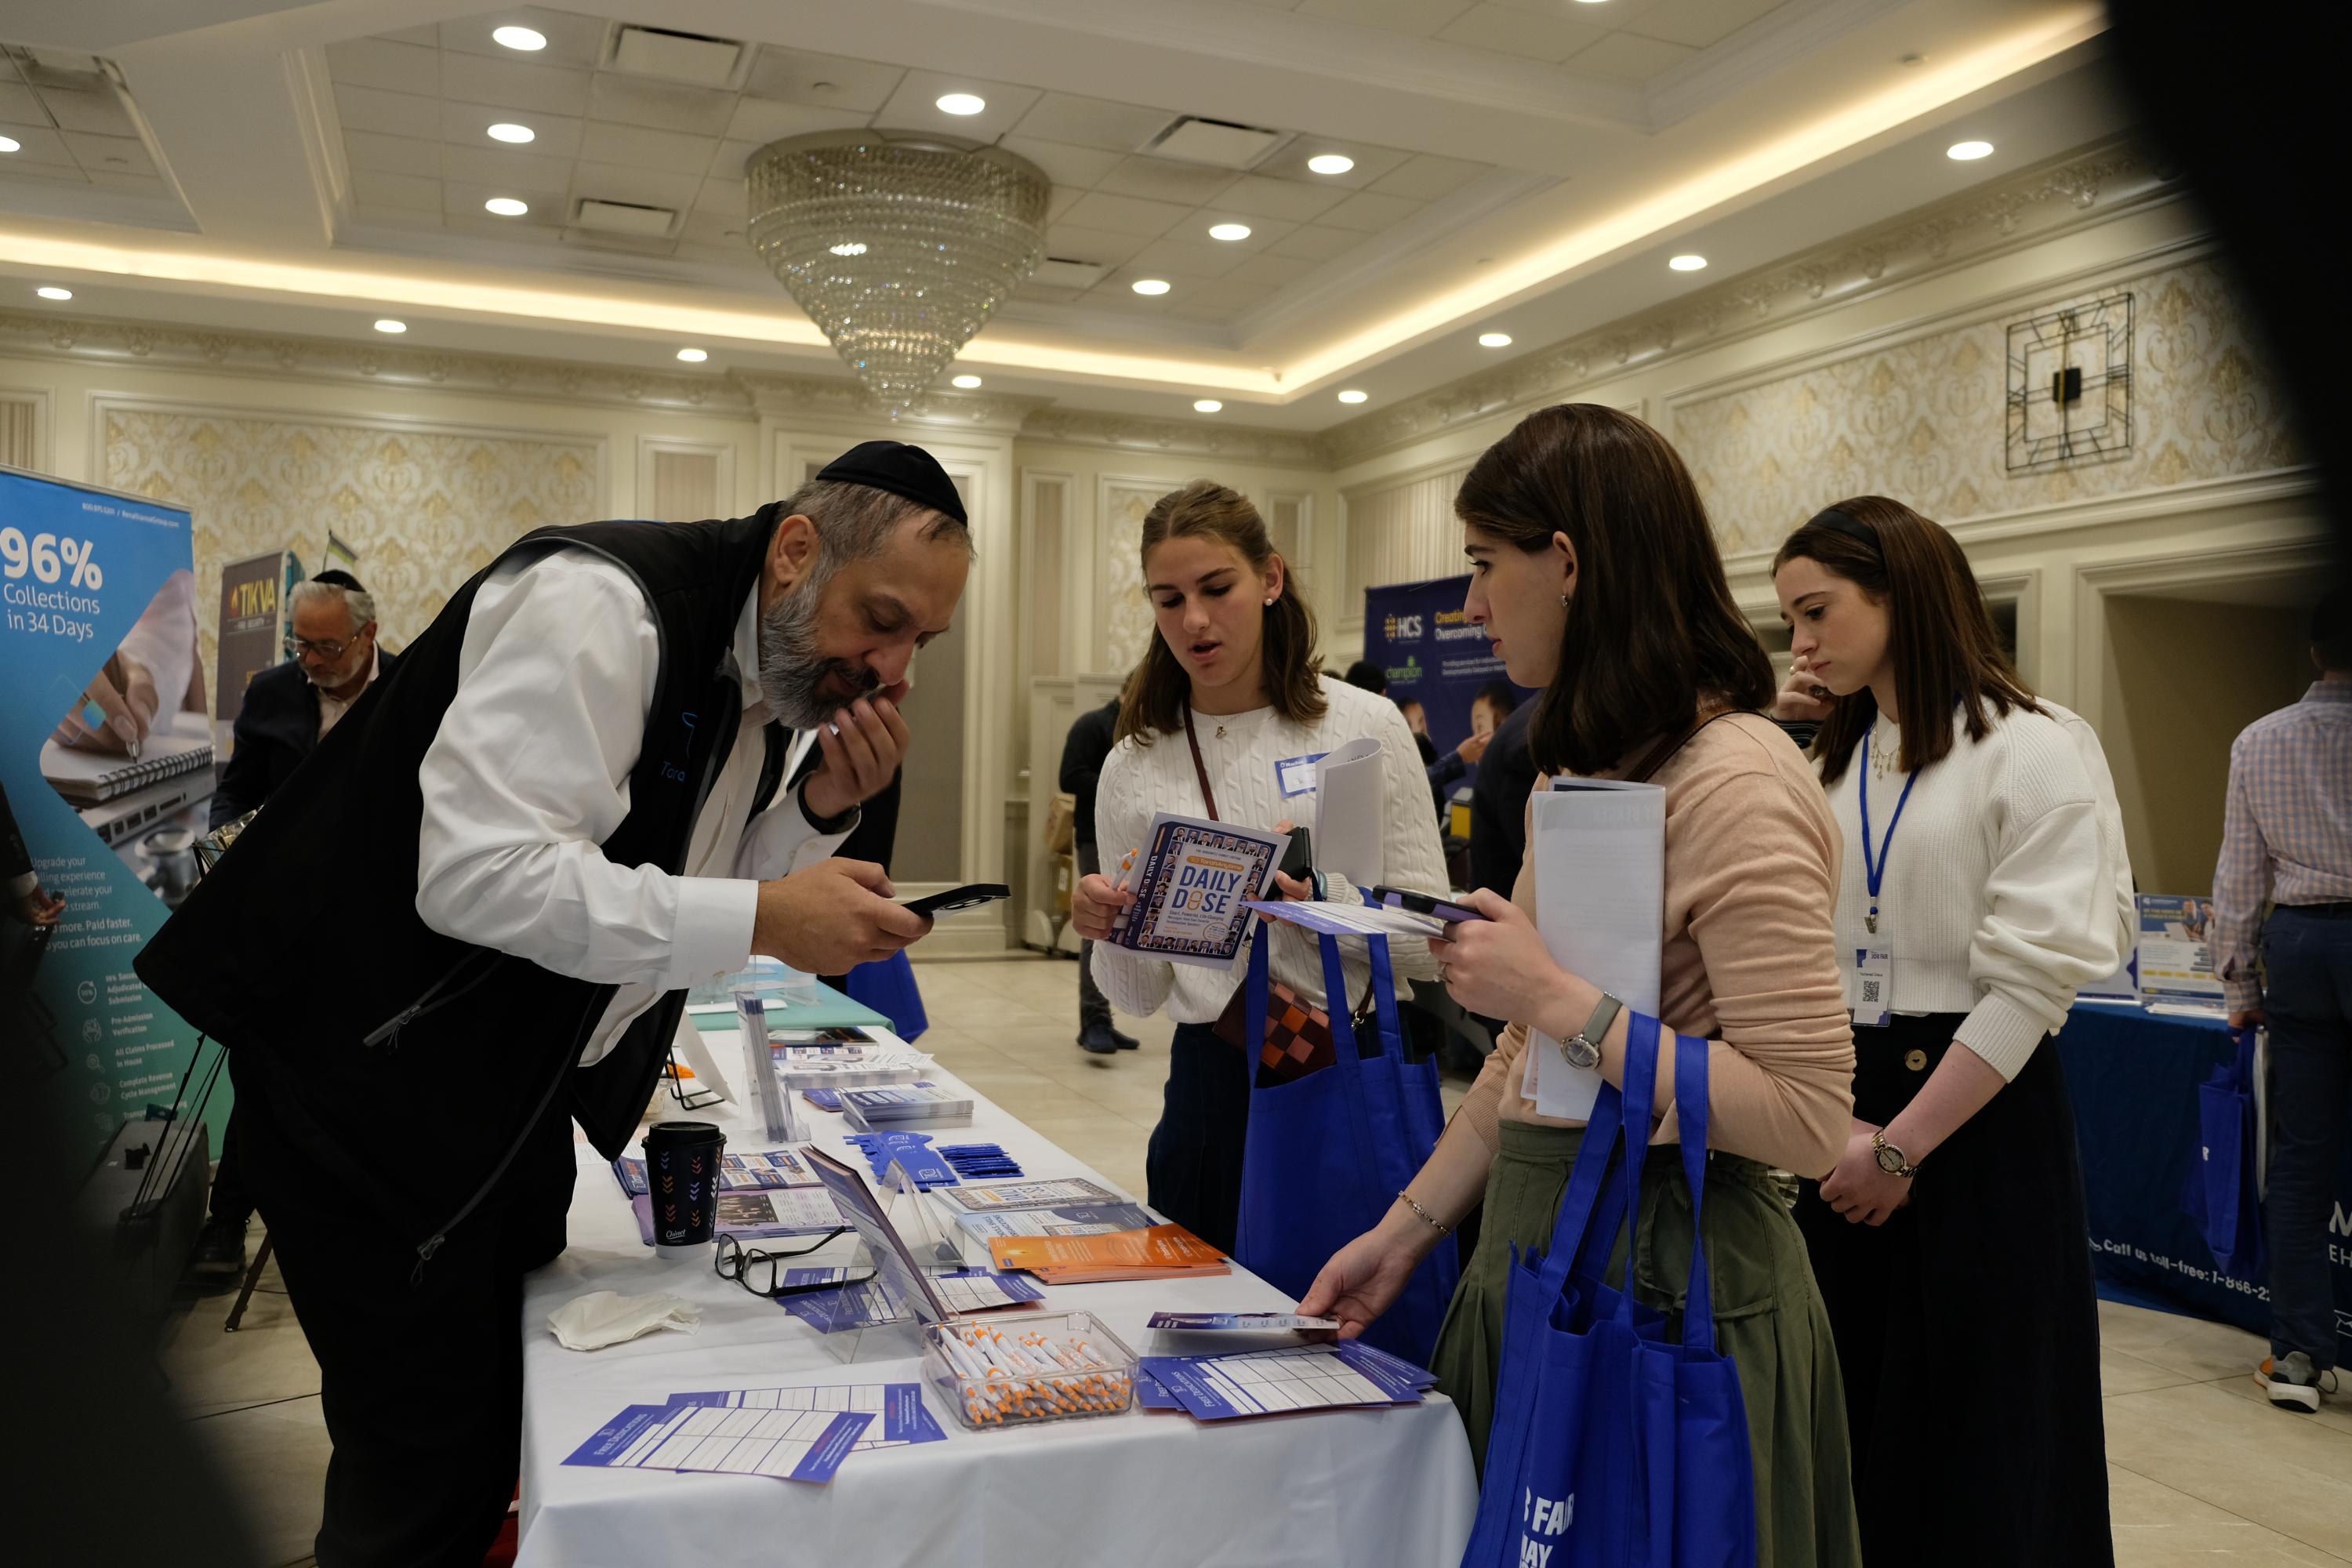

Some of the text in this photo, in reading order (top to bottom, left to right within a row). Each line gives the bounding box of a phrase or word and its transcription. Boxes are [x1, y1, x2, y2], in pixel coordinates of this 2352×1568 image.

[0, 526, 103, 590] 96%
[3, 583, 100, 614] Collections
[7, 608, 94, 643] in 34 Days
[1398, 615, 1423, 638] HCS
[1436, 625, 1482, 641] Overcoming
[67, 856, 86, 868] your
[1145, 855, 1158, 877] DAILY
[38, 870, 106, 885] illing experience
[1178, 865, 1242, 893] DAILY
[94, 885, 113, 898] your
[1171, 888, 1231, 914] DOSE
[60, 923, 85, 933] more.
[85, 919, 106, 931] Paid
[106, 918, 132, 929] faster.
[53, 942, 70, 953] you
[70, 939, 86, 949] can
[87, 935, 110, 947] focus
[111, 936, 122, 945] on
[123, 933, 143, 943] care.
[112, 1025, 147, 1036] Verification
[119, 1072, 173, 1088] Complete Revenue
[121, 1082, 176, 1101] Cycle Management
[666, 1229, 686, 1240] Chinet
[2103, 1239, 2131, 1257] Call
[2135, 1248, 2148, 1262] us
[2151, 1252, 2210, 1281] toll-free:
[1532, 1493, 1575, 1536] FAIR
